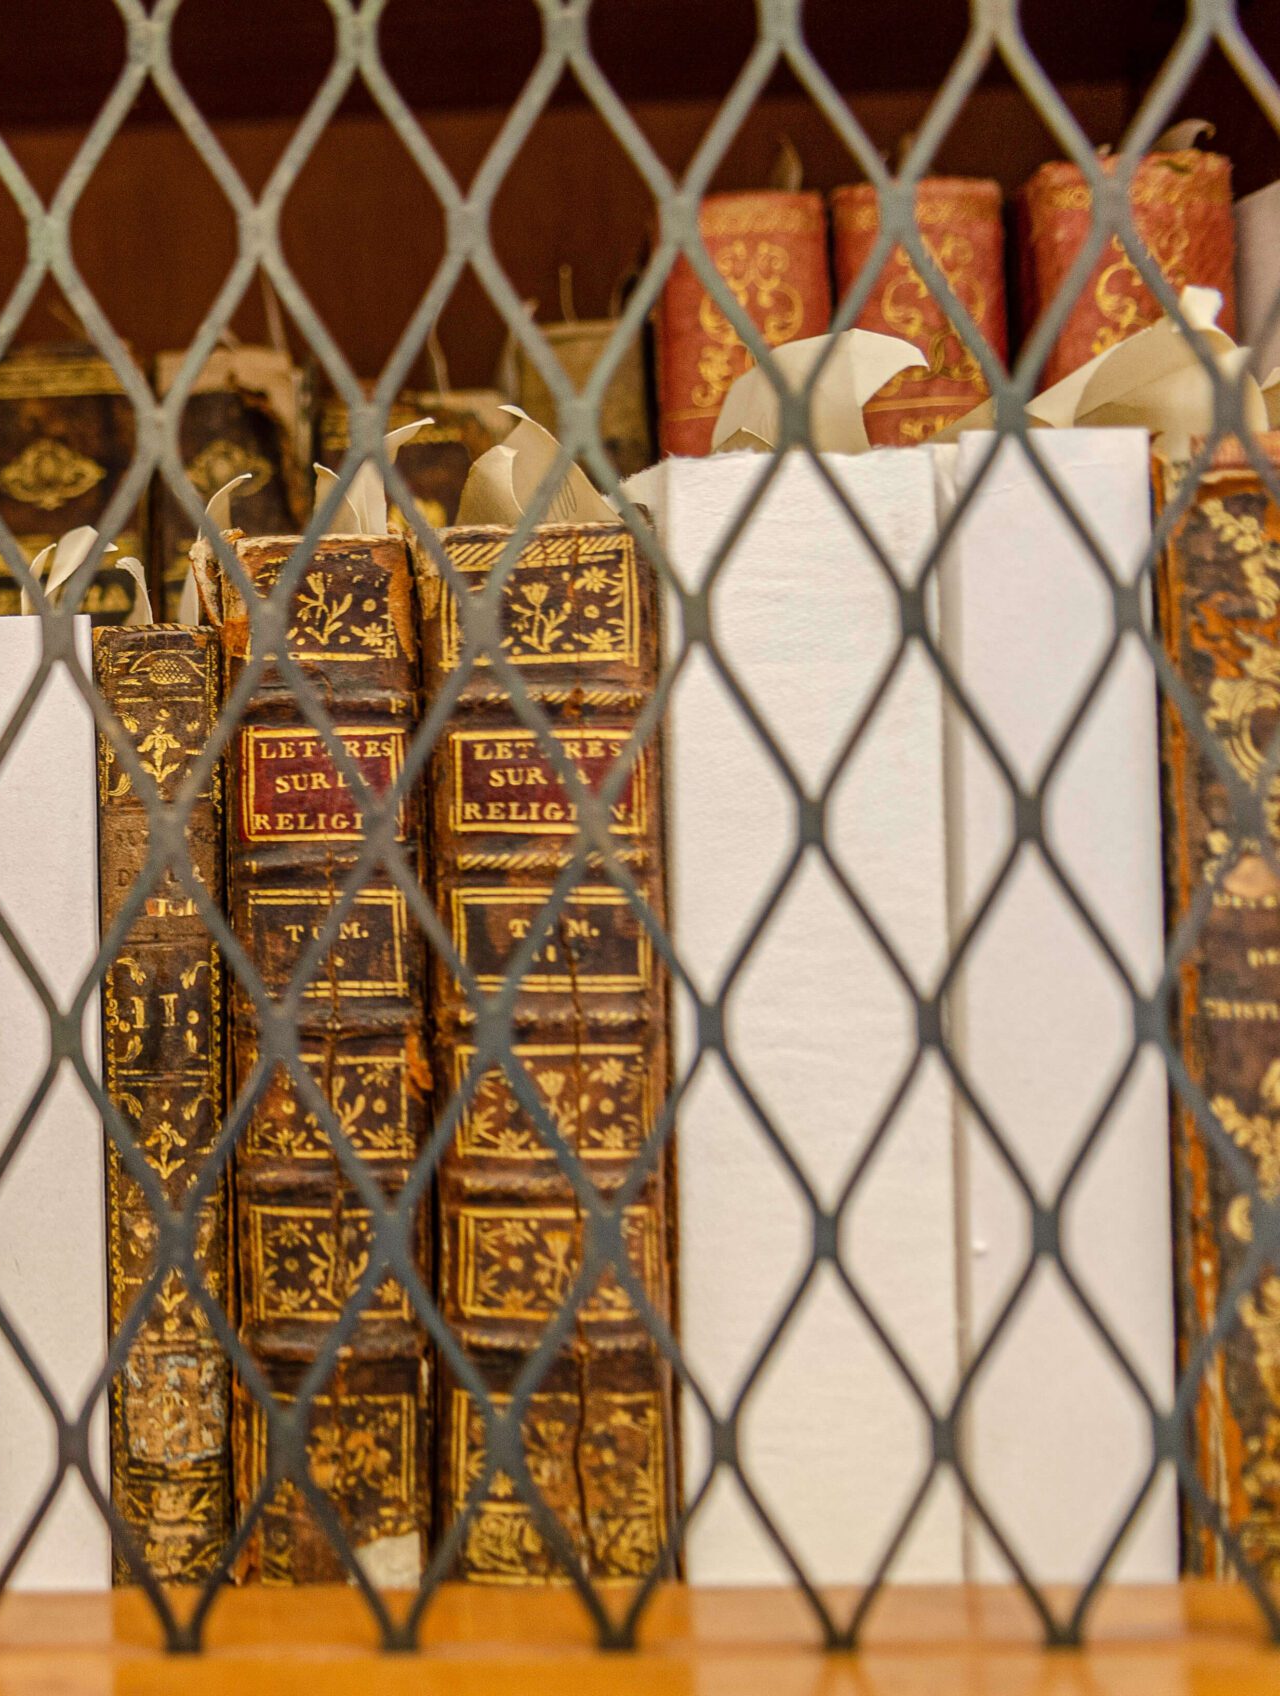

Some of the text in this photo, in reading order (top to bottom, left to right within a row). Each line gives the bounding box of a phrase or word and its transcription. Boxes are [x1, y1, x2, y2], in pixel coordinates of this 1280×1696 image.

[473, 740, 623, 761] LETRES
[275, 771, 331, 794] SUR
[489, 766, 548, 788] SUR
[253, 812, 403, 831] RELIGI
[464, 801, 634, 821] RELIGIN.
[508, 917, 600, 939] TM.
